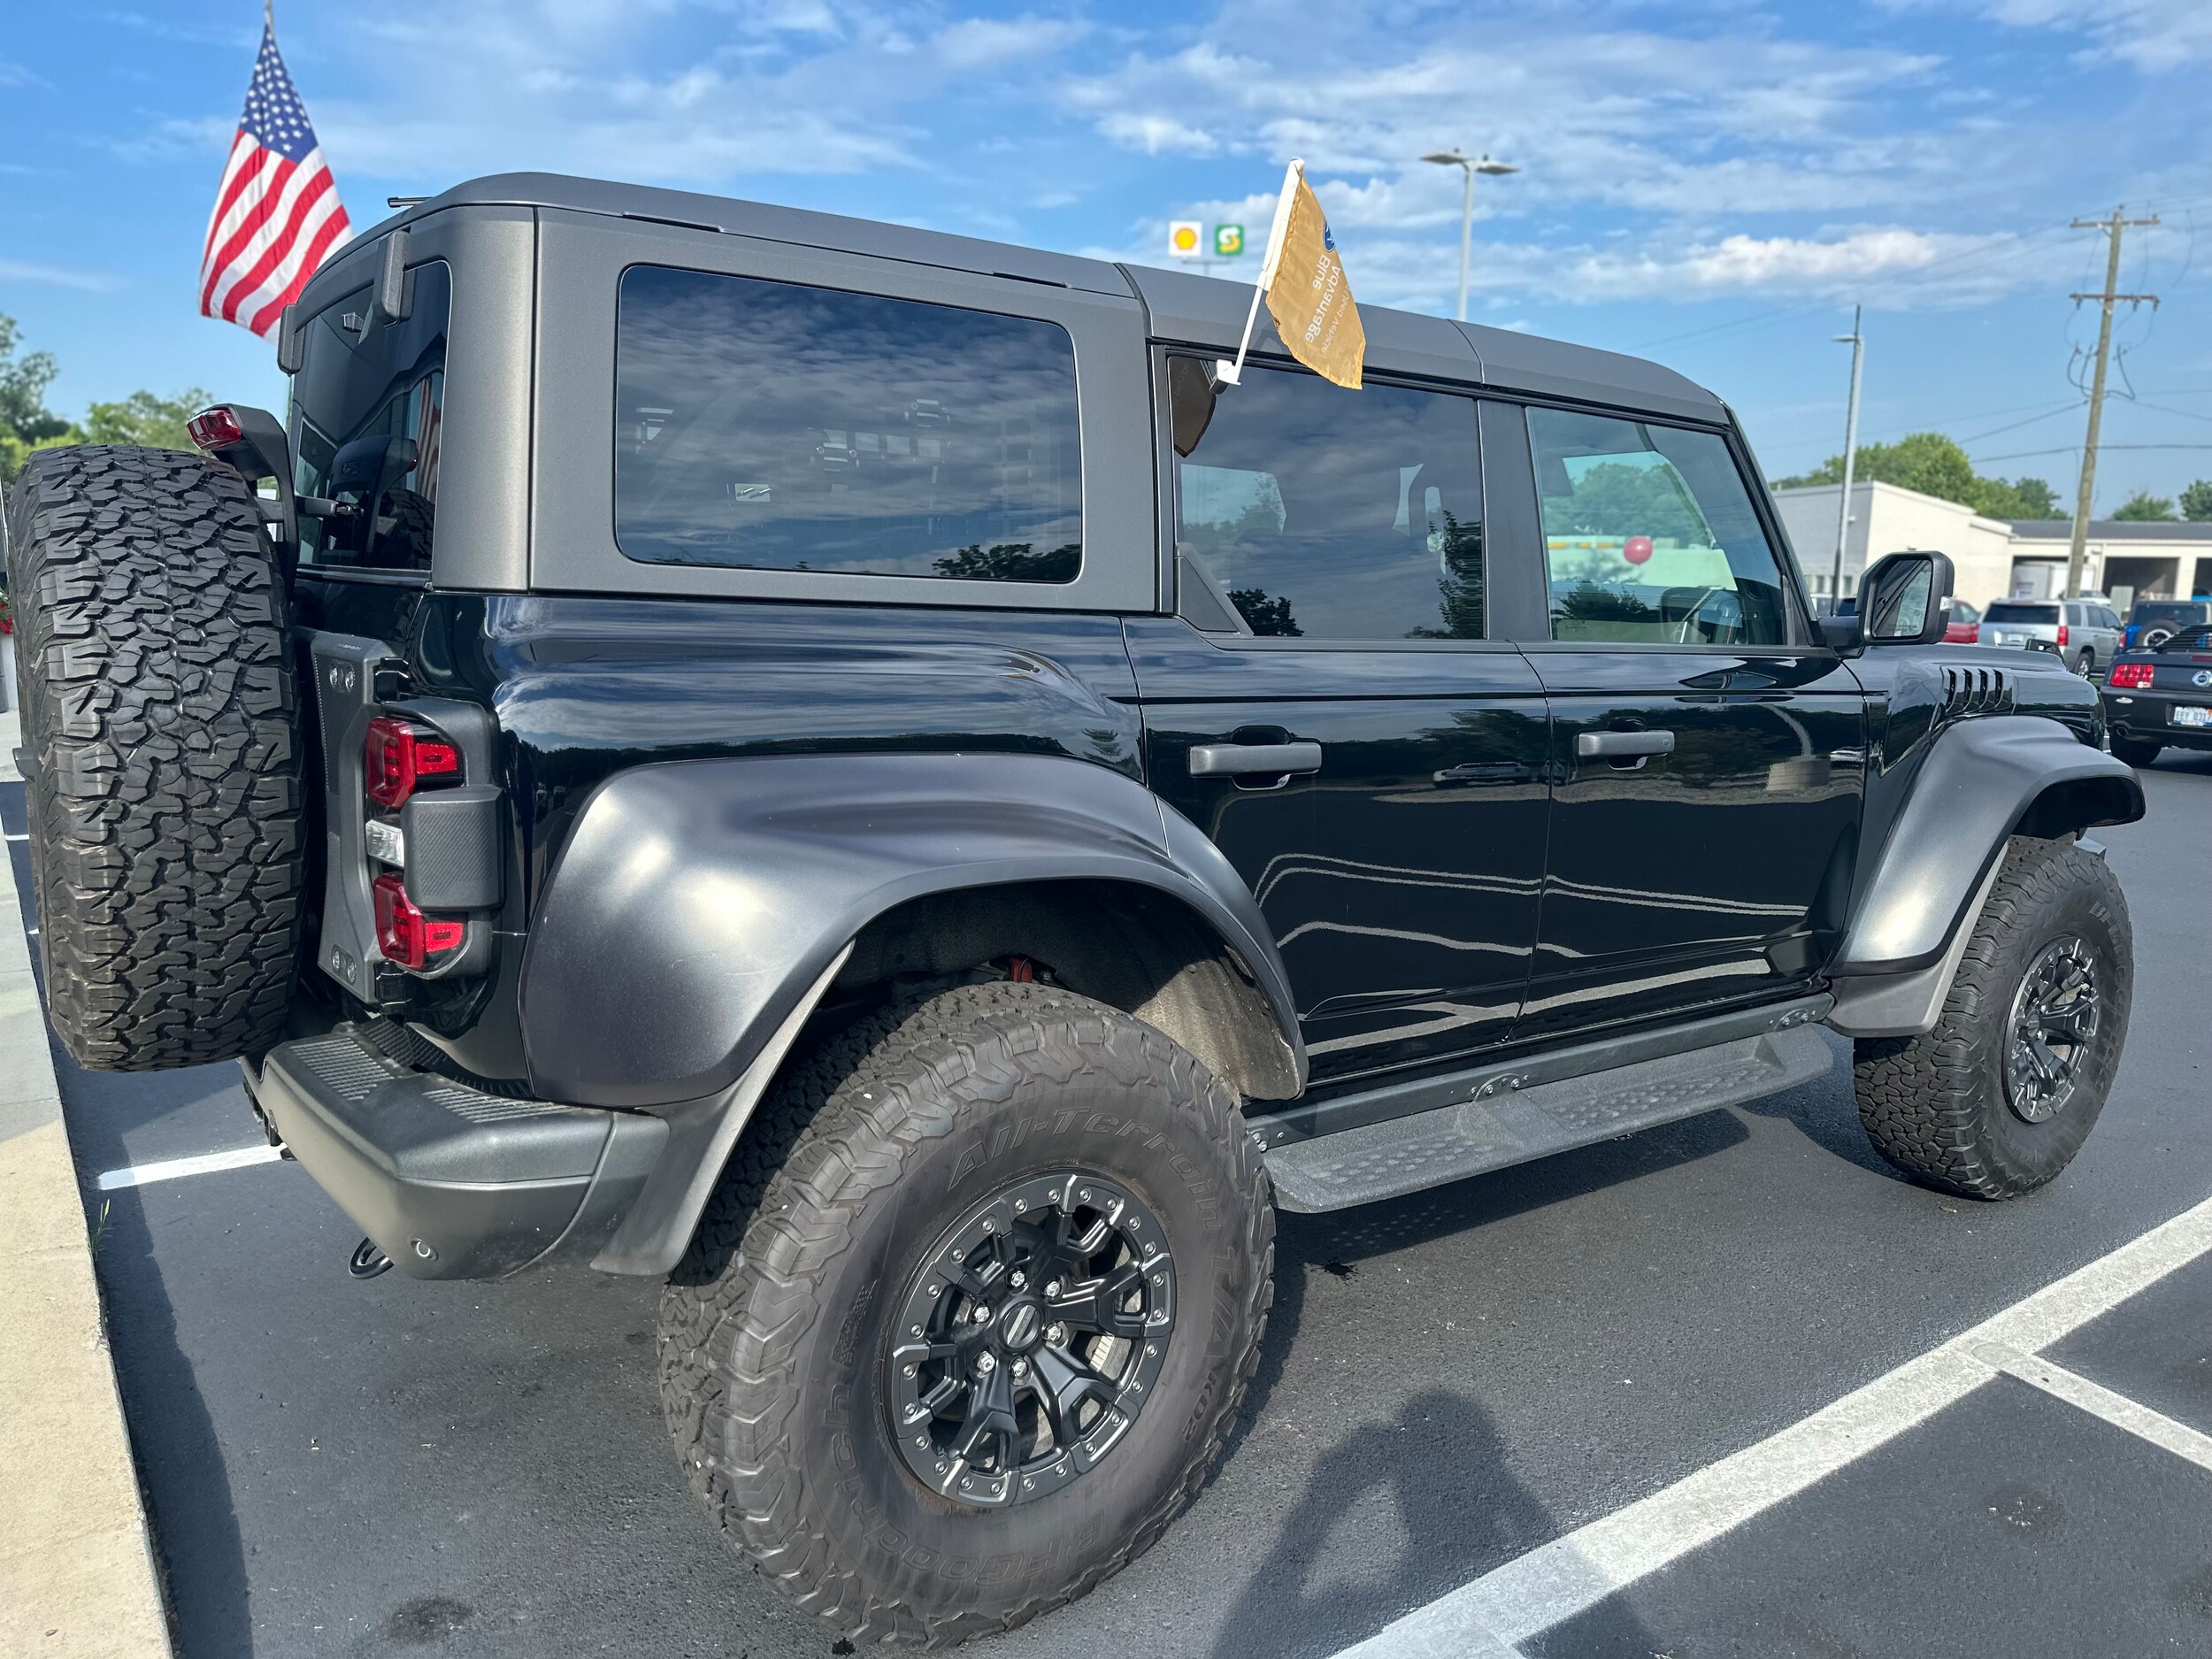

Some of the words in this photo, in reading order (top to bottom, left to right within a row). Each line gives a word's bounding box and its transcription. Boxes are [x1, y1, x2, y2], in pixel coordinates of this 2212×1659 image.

[948, 1107, 1223, 1230] All-Terrain
[1204, 1247, 1235, 1356] T/A
[824, 1383, 1104, 1586] BFGoodrich
